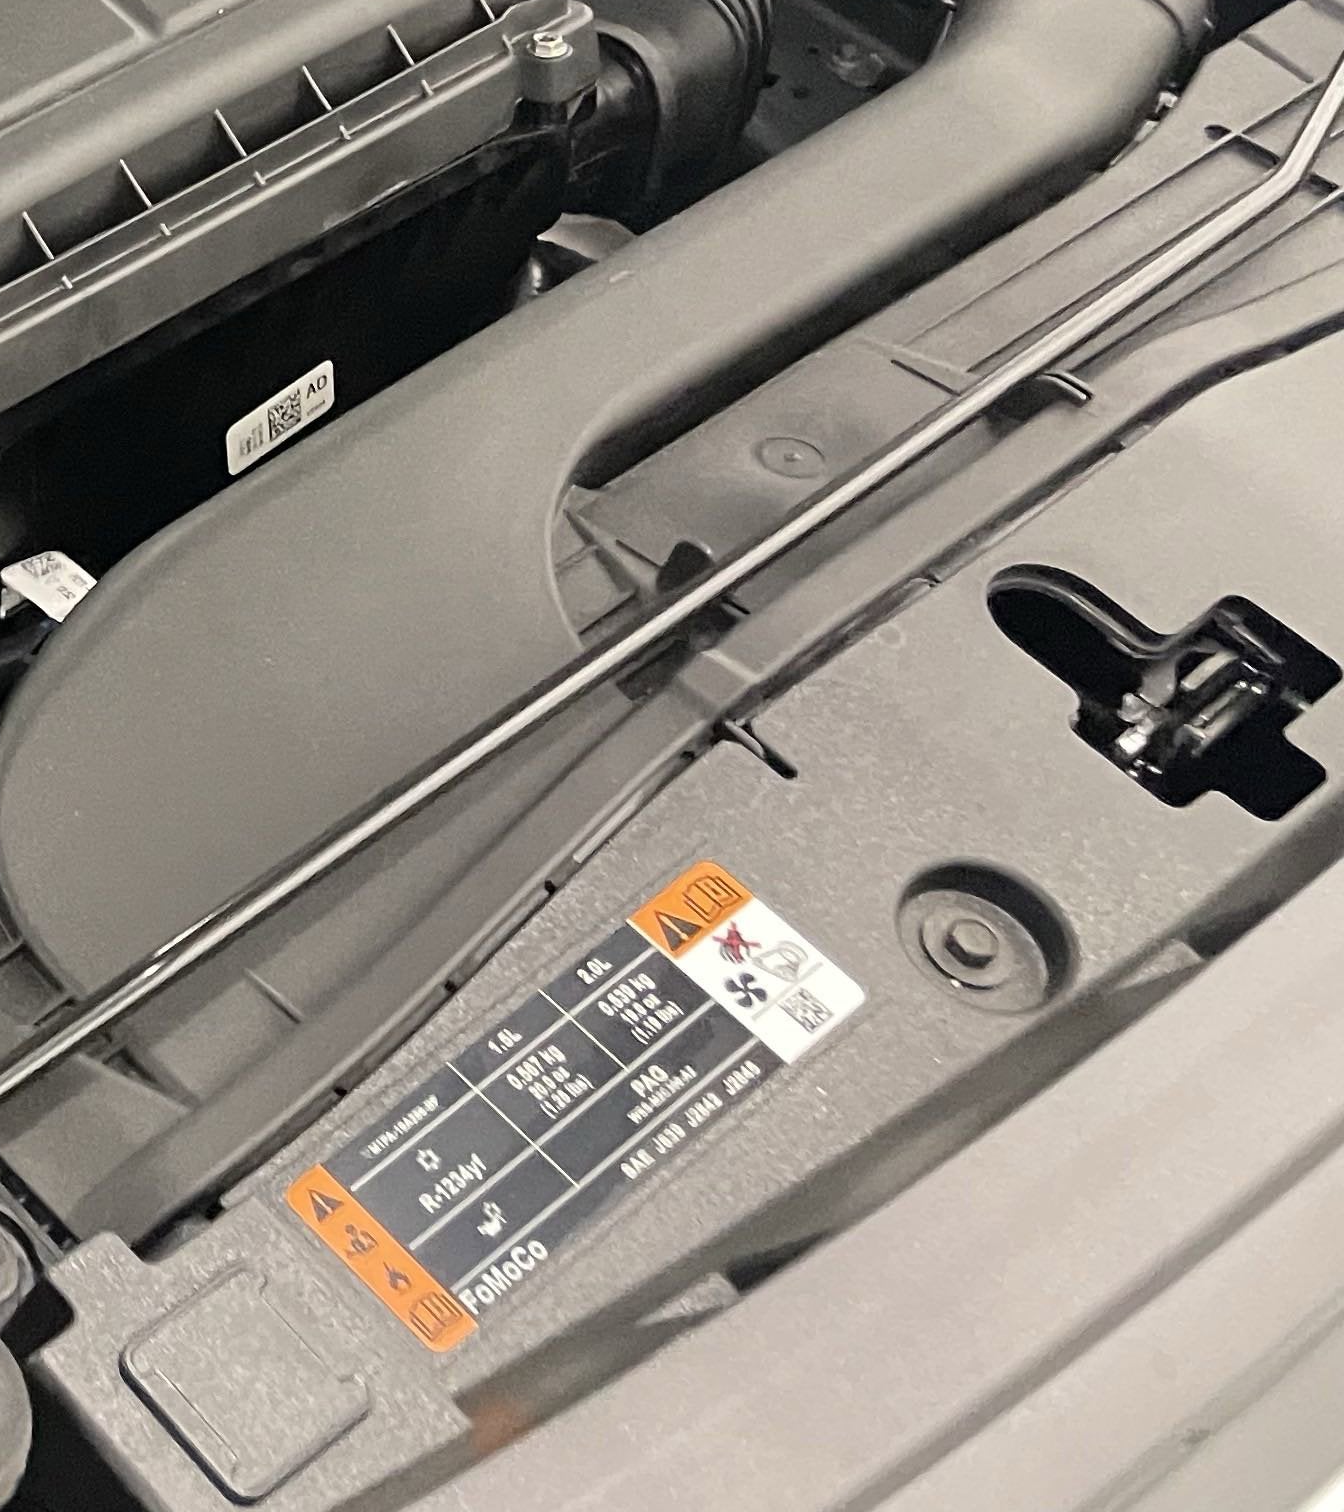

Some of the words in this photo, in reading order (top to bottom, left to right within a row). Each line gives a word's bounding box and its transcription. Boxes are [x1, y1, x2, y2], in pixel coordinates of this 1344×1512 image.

[576, 957, 612, 984] 2.0L
[418, 1152, 486, 1213] R-1234yf
[458, 1240, 548, 1315] FoMoCo
